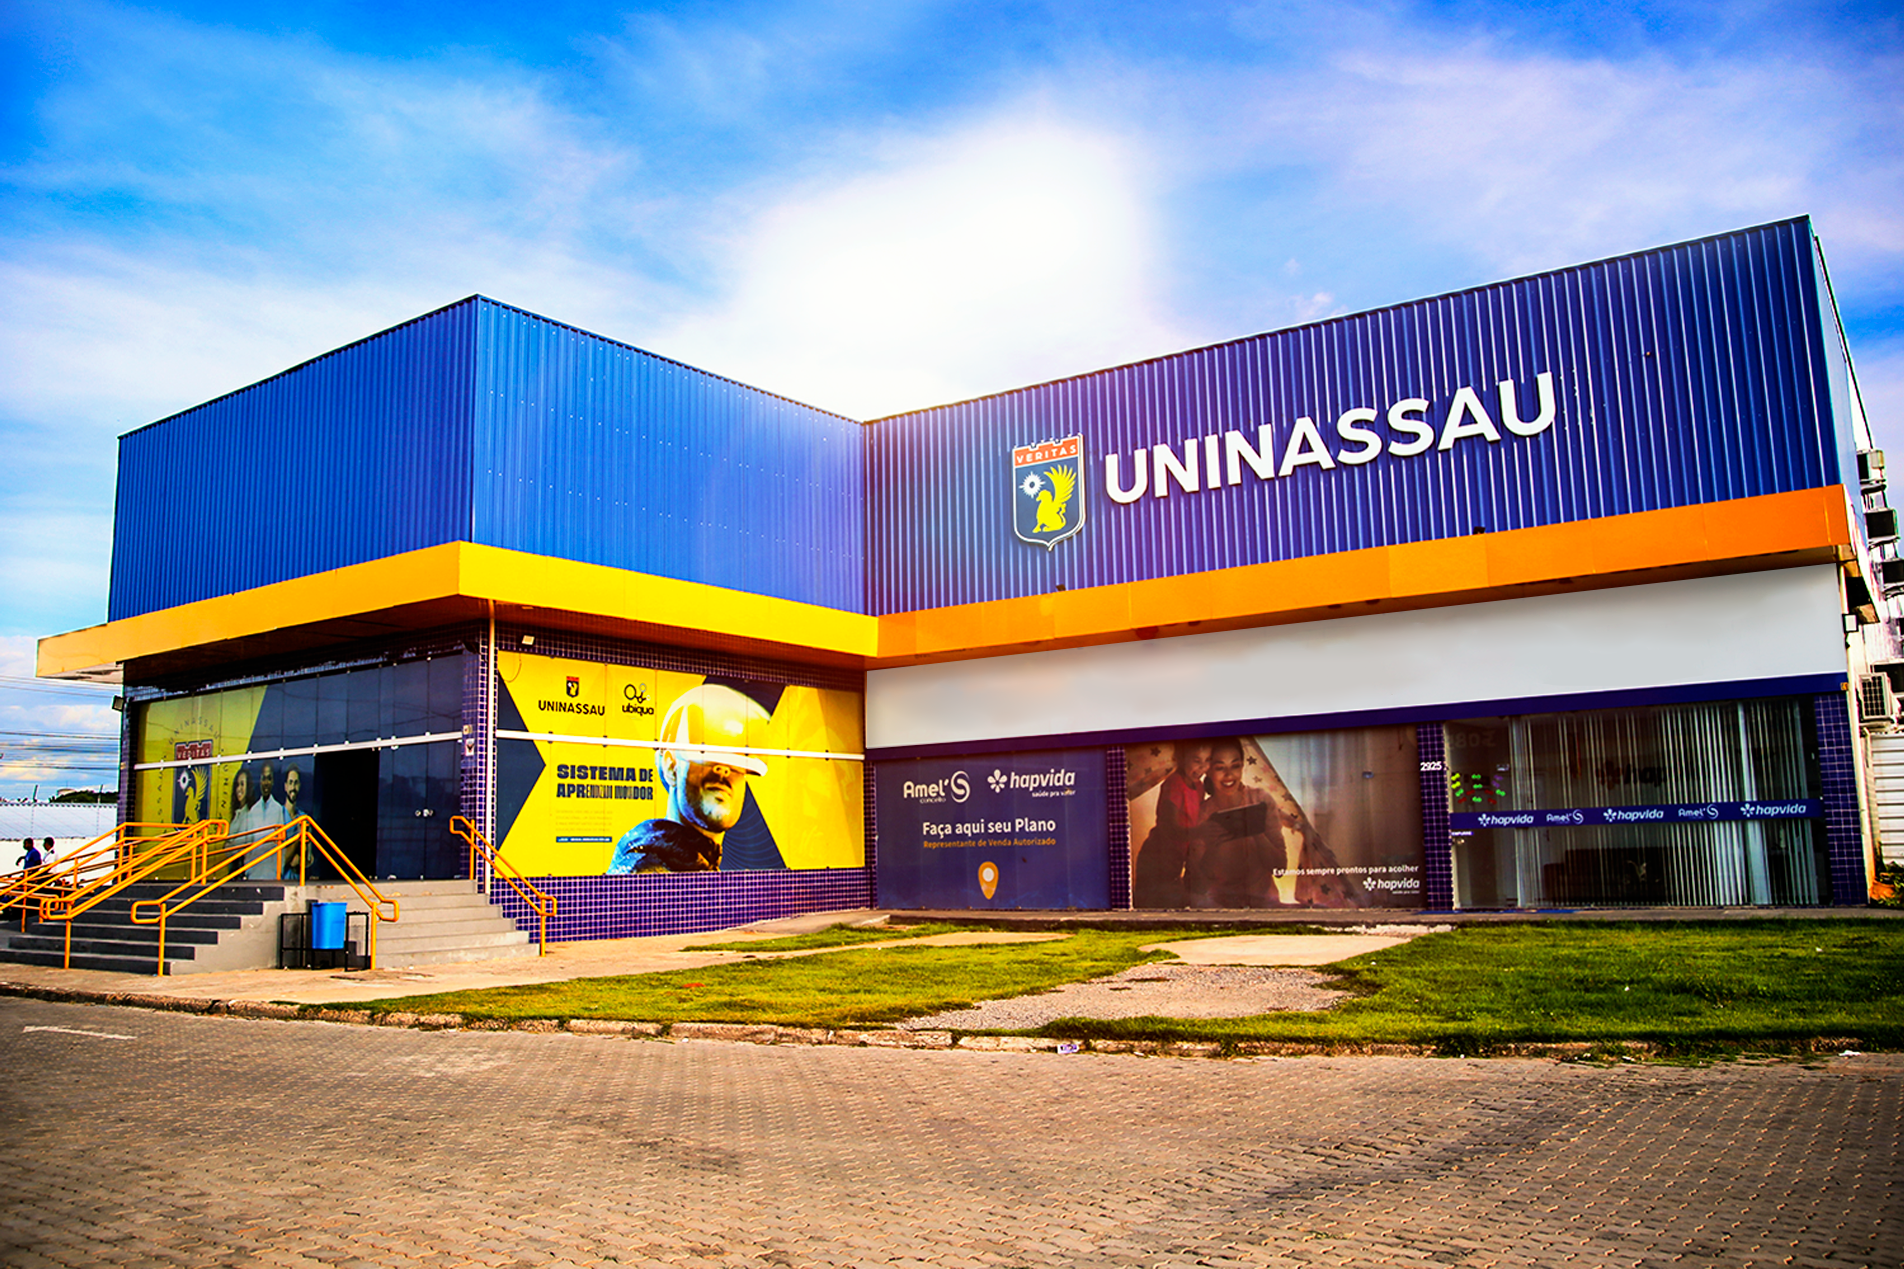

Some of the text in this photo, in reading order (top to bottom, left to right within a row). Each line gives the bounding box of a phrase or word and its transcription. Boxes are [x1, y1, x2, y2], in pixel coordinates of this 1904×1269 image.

[1105, 371, 1556, 503] UNINASSAU
[1016, 445, 1076, 464] VERITAS
[538, 700, 605, 716] UNINASSAU
[622, 703, 655, 716] ubiqua
[557, 764, 653, 782] SISTEMA DE
[1010, 768, 1075, 791] hapvida
[1617, 808, 1664, 821] hapvida
[1755, 803, 1806, 816] hapvida
[1490, 814, 1534, 826] hapvida
[922, 817, 1056, 839] Faça aqui seu Plano
[923, 837, 1056, 850] Representante de Venda Autorizado
[1272, 865, 1419, 877] Estamos sempre prontos para acolher
[1377, 877, 1420, 891] hapvida
